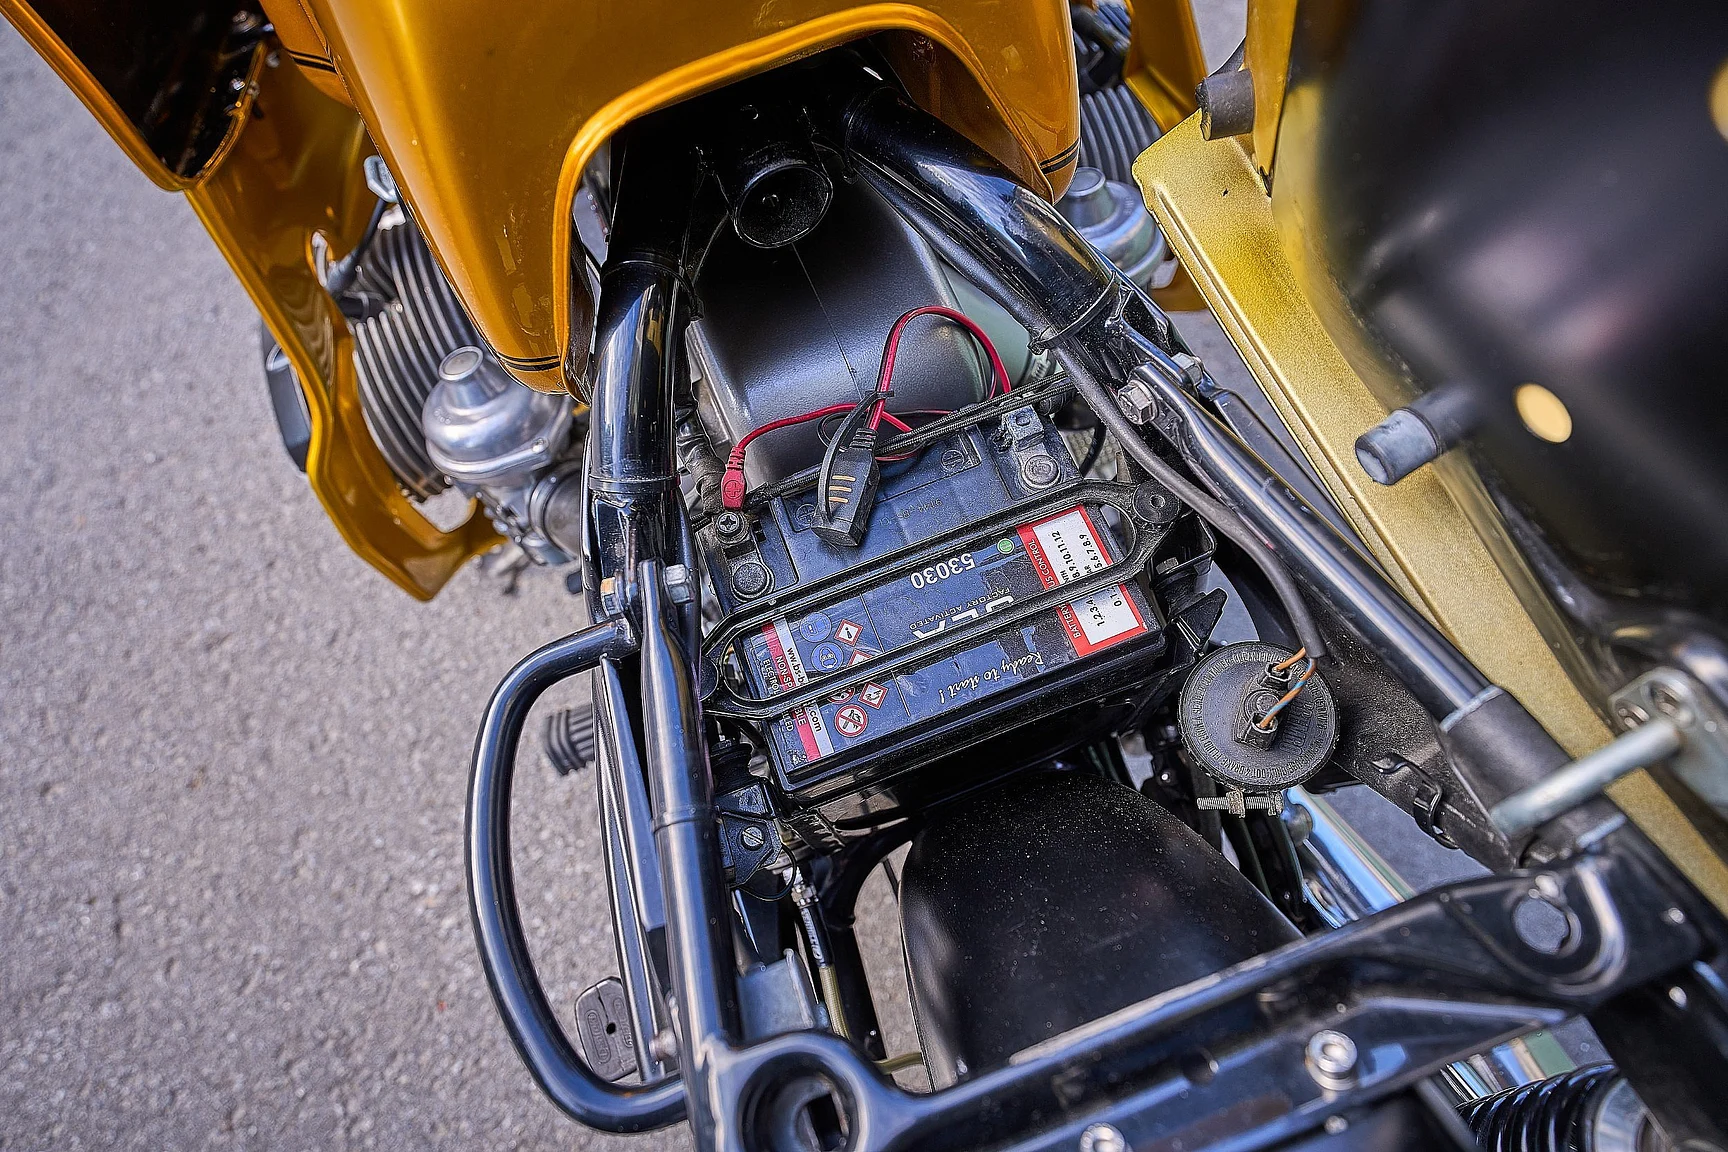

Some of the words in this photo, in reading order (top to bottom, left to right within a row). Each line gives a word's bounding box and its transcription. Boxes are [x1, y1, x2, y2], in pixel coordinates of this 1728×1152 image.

[1028, 539, 1050, 576] CONTROL
[910, 553, 975, 589] 53030
[967, 588, 1010, 609] FACTORY
[909, 606, 962, 630] ACTIVATED
[983, 669, 1001, 681] to
[1000, 652, 1044, 675] Ready
[948, 675, 980, 698] start
[1203, 741, 1220, 760] FLUID
